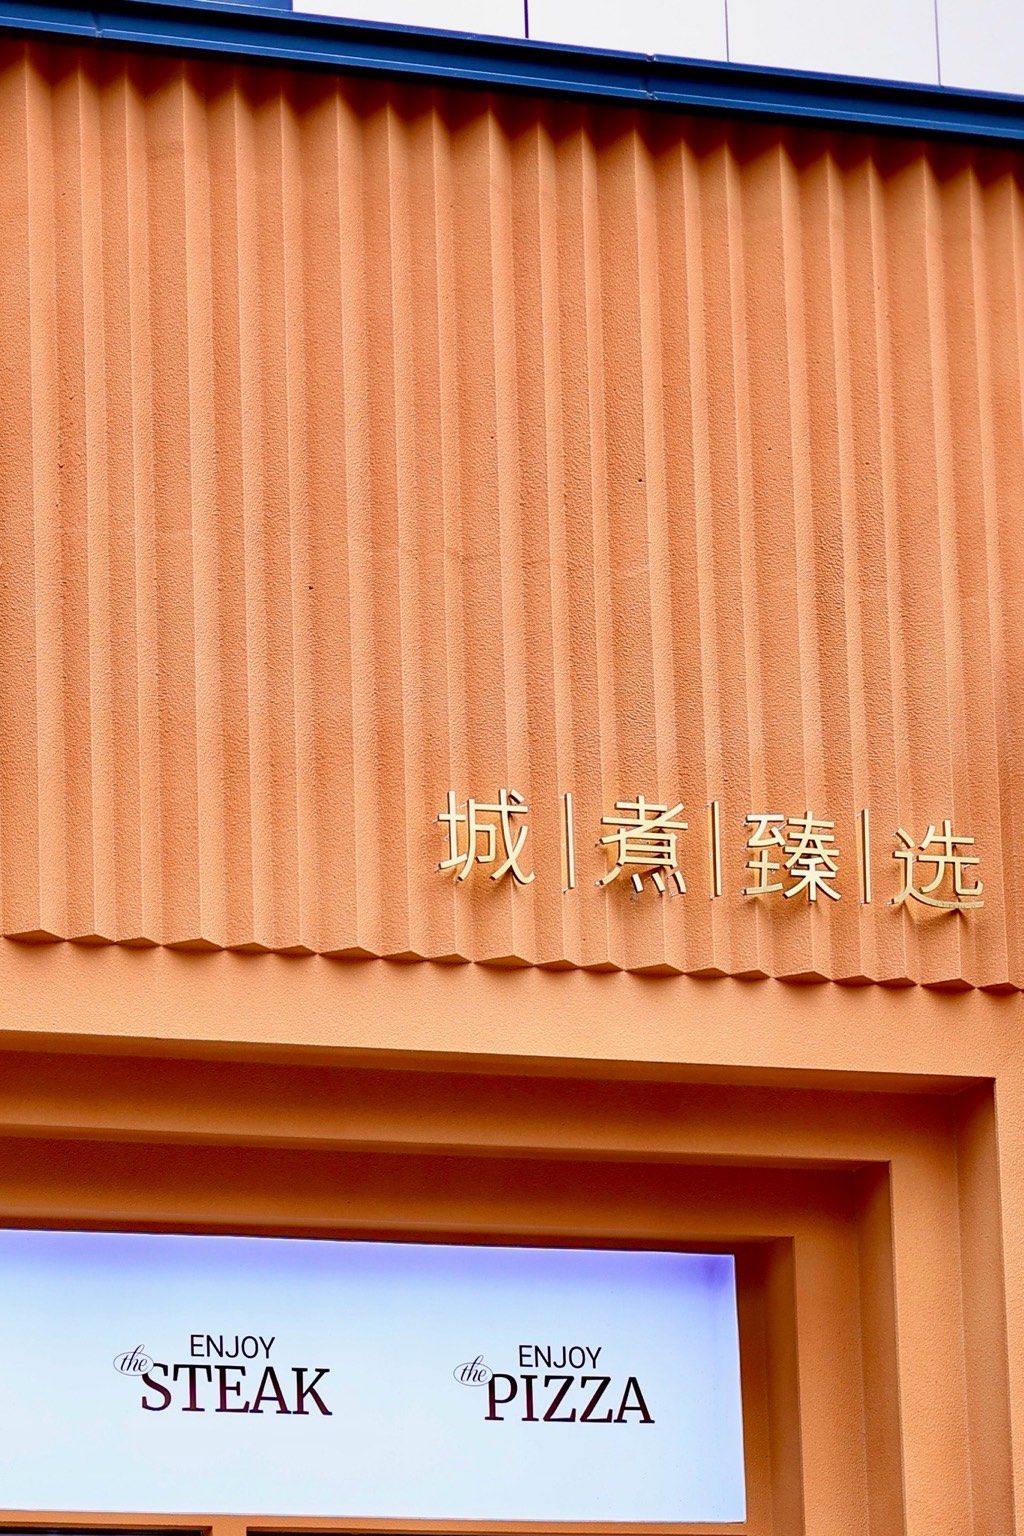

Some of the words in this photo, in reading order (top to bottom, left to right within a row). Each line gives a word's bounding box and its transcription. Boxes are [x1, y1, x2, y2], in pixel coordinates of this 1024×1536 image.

[190, 1334, 276, 1359] ENJOY
[519, 1344, 602, 1369] ENJOY
[120, 1344, 149, 1372] the
[142, 1363, 333, 1415] STEAK
[459, 1355, 488, 1383] the
[484, 1373, 655, 1424] PIZZA
